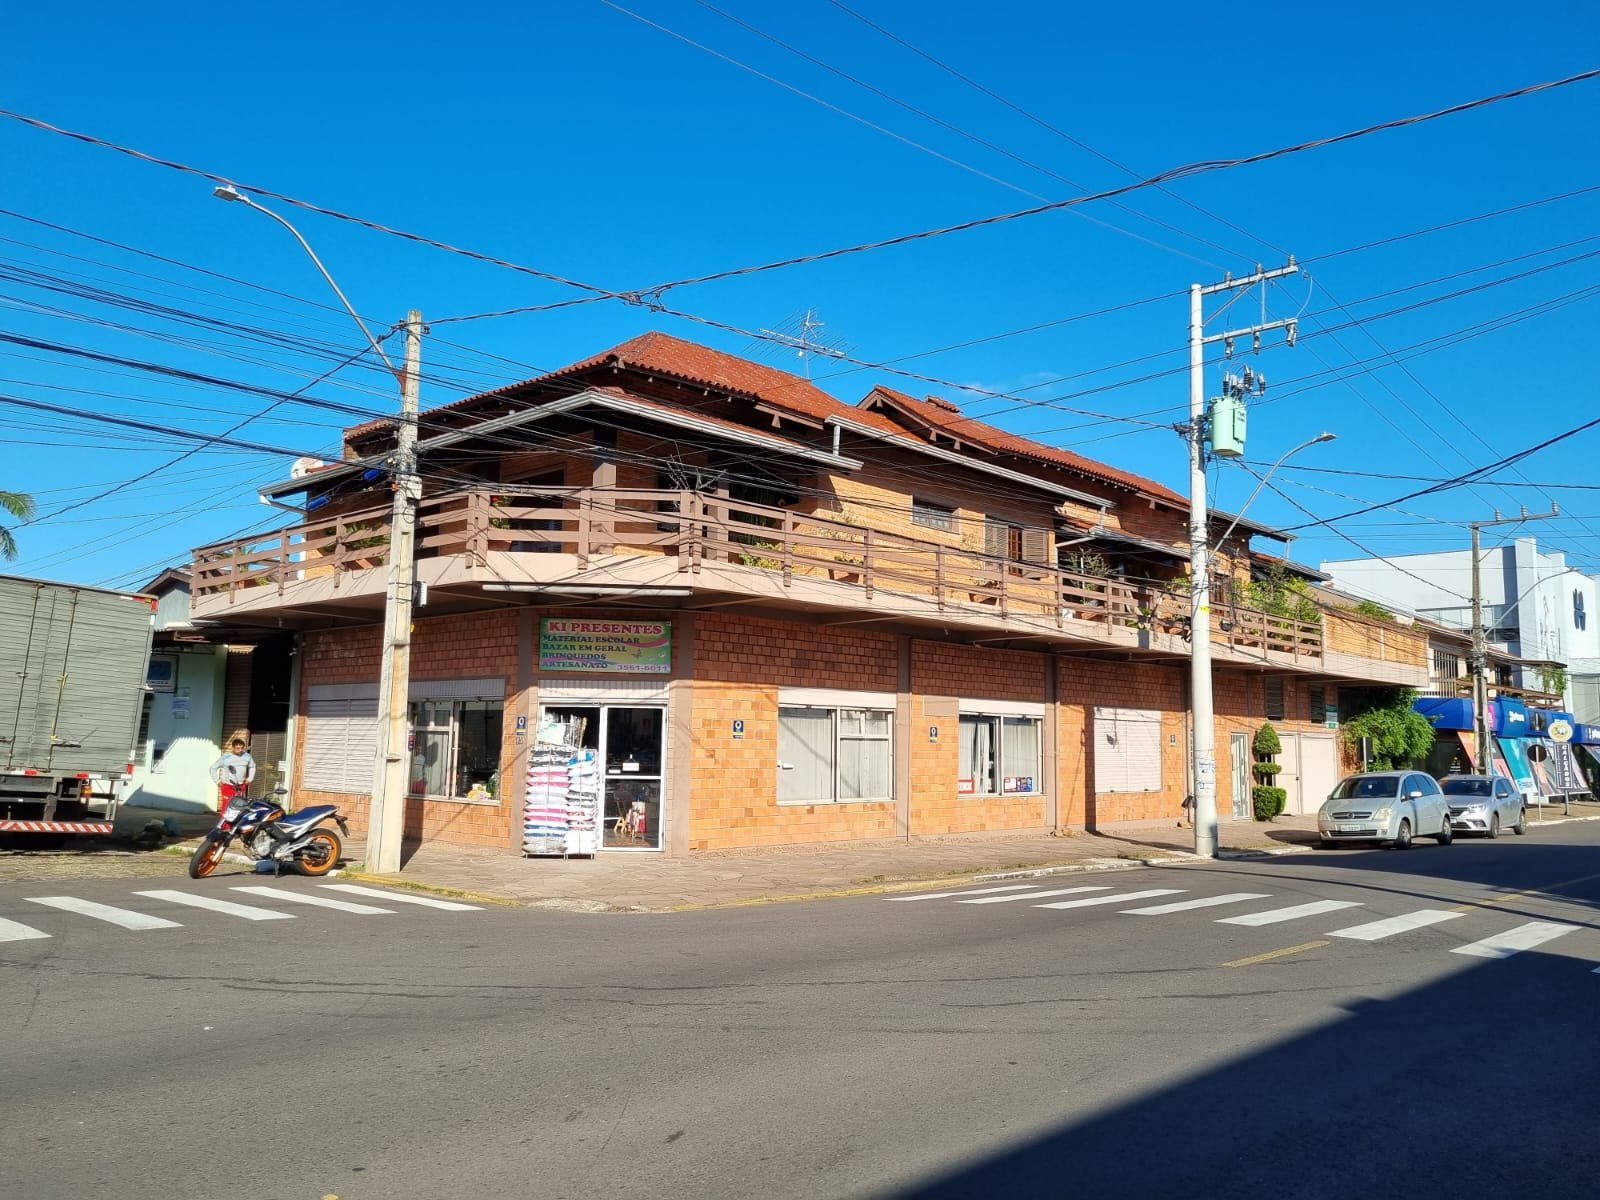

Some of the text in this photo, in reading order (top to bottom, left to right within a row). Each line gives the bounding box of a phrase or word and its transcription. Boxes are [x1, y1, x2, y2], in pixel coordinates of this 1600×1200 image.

[549, 622, 662, 634] KI PRESENTES
[595, 636, 640, 644] ESCOLAR
[543, 652, 607, 660] BRINQUEDOS
[542, 661, 608, 669] ARTESANATO
